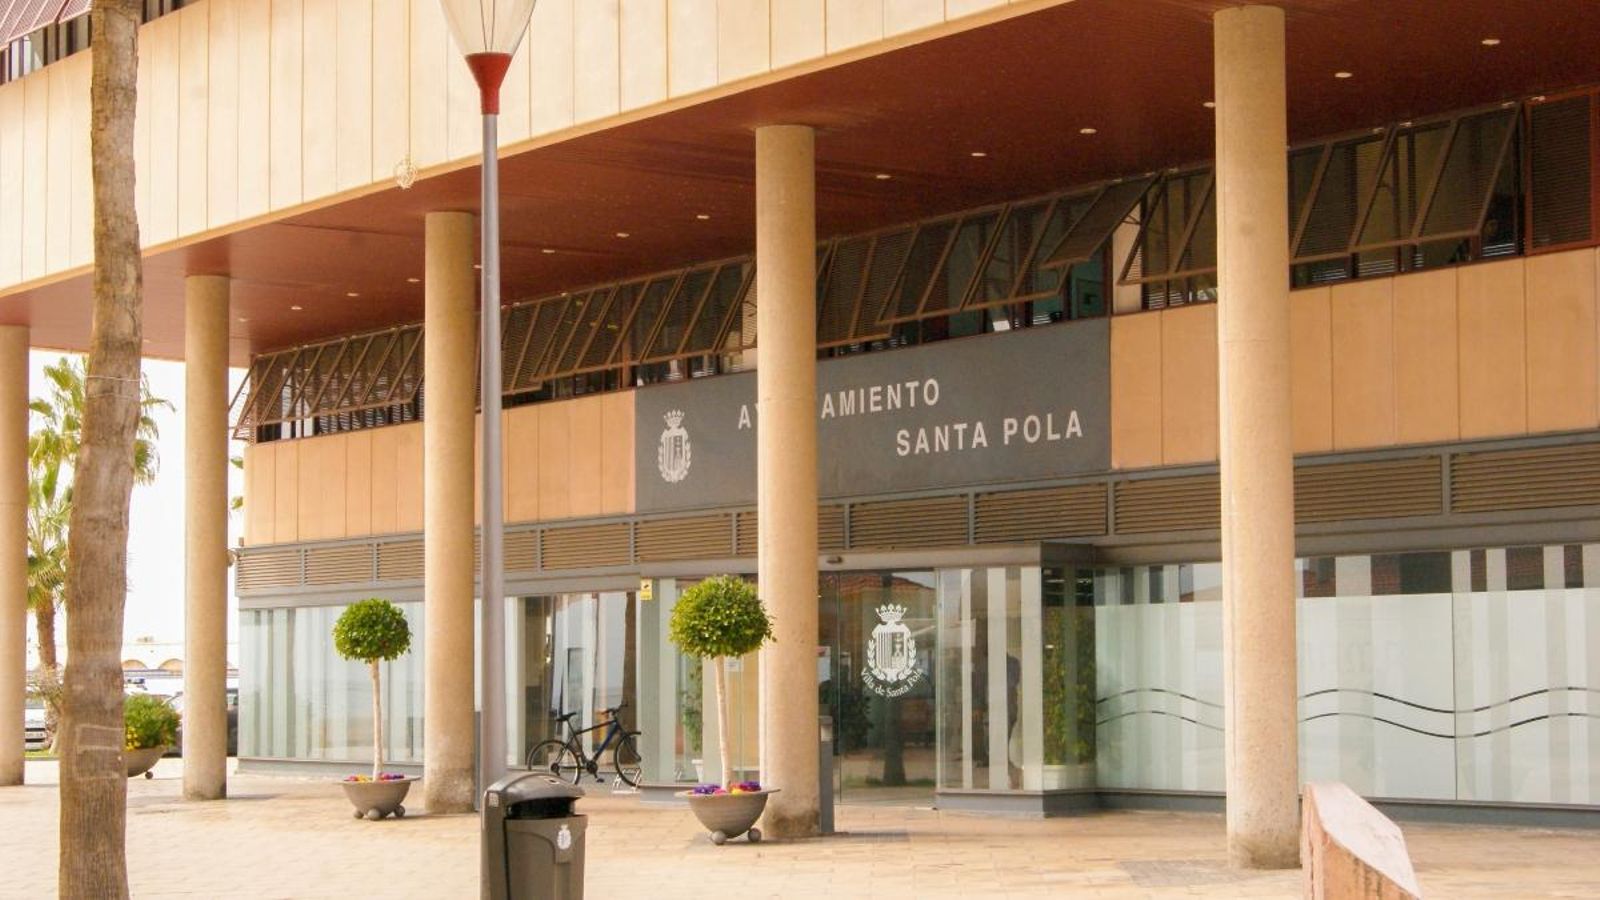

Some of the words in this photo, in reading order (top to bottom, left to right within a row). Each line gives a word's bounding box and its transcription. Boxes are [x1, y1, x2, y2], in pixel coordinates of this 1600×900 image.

[738, 378, 940, 430] AAMIENTO
[897, 421, 988, 457] SANTA
[1003, 410, 1083, 445] POLA
[875, 684, 886, 696] de
[886, 684, 909, 698] Santa
